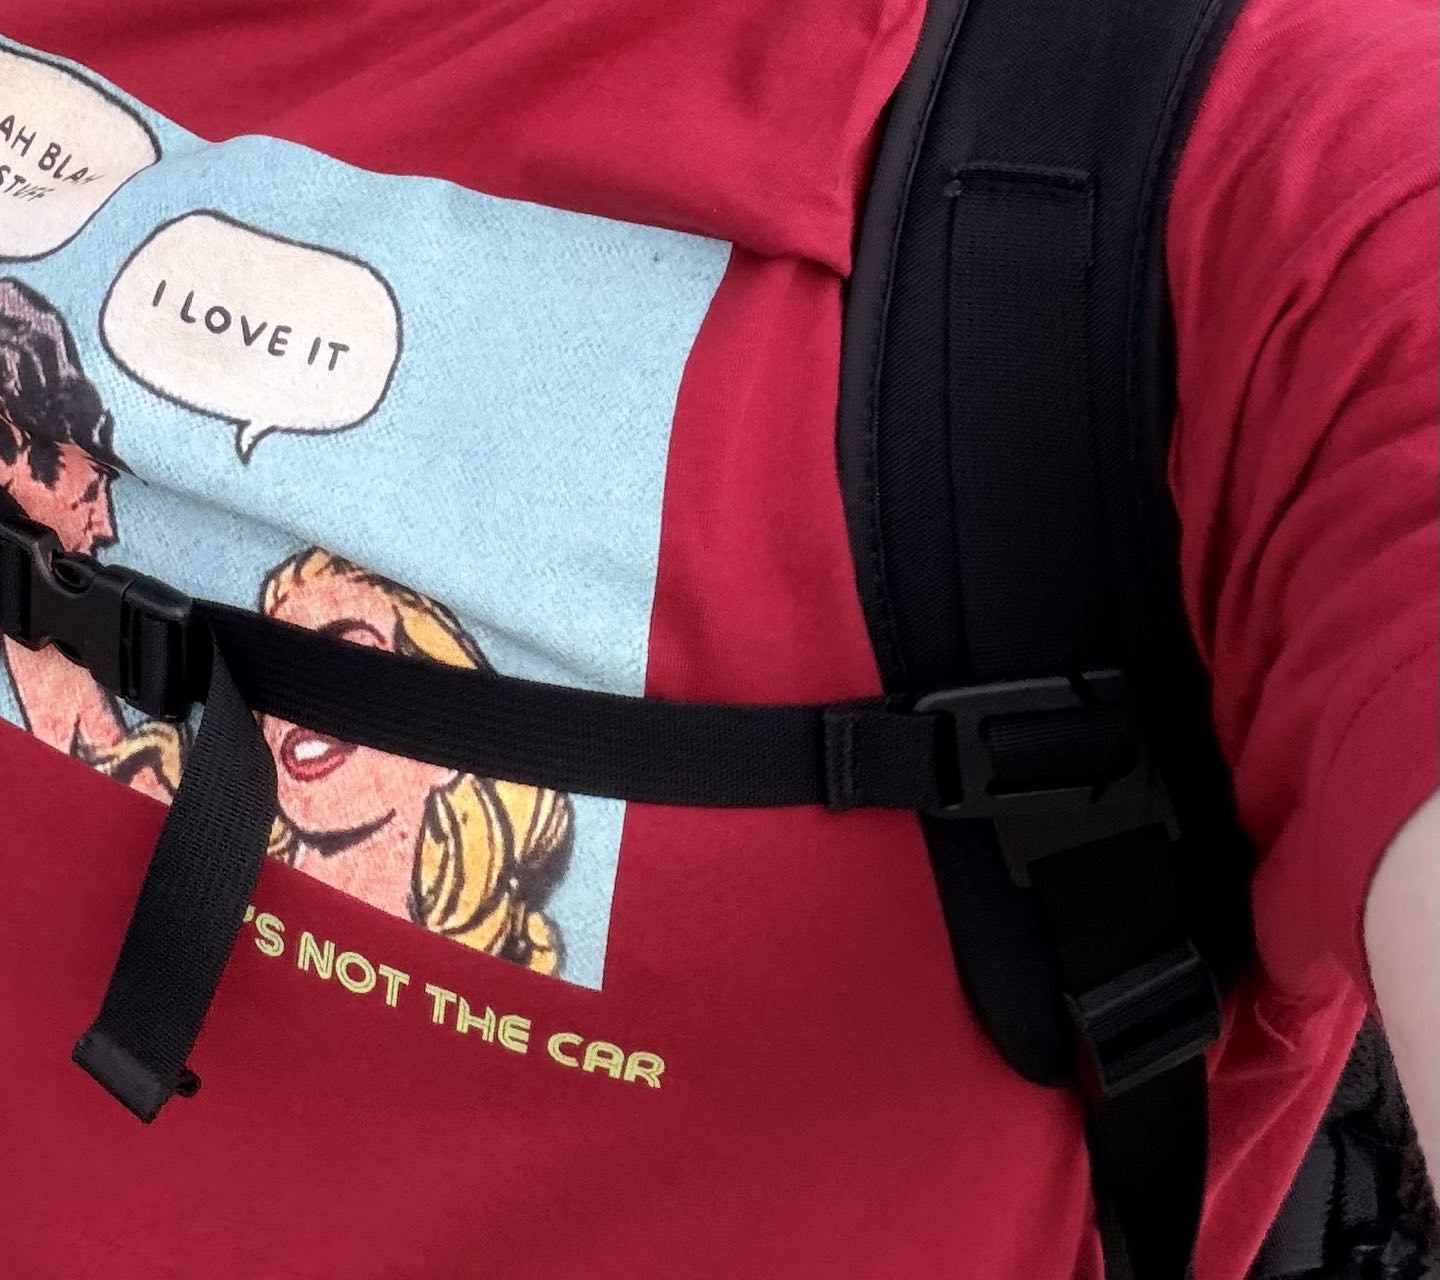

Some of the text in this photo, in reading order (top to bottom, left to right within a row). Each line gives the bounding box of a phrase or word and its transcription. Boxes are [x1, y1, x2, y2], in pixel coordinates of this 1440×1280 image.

[152, 279, 352, 372] I LOVE IT
[242, 905, 667, 1089] 'S NOT THE CAR
